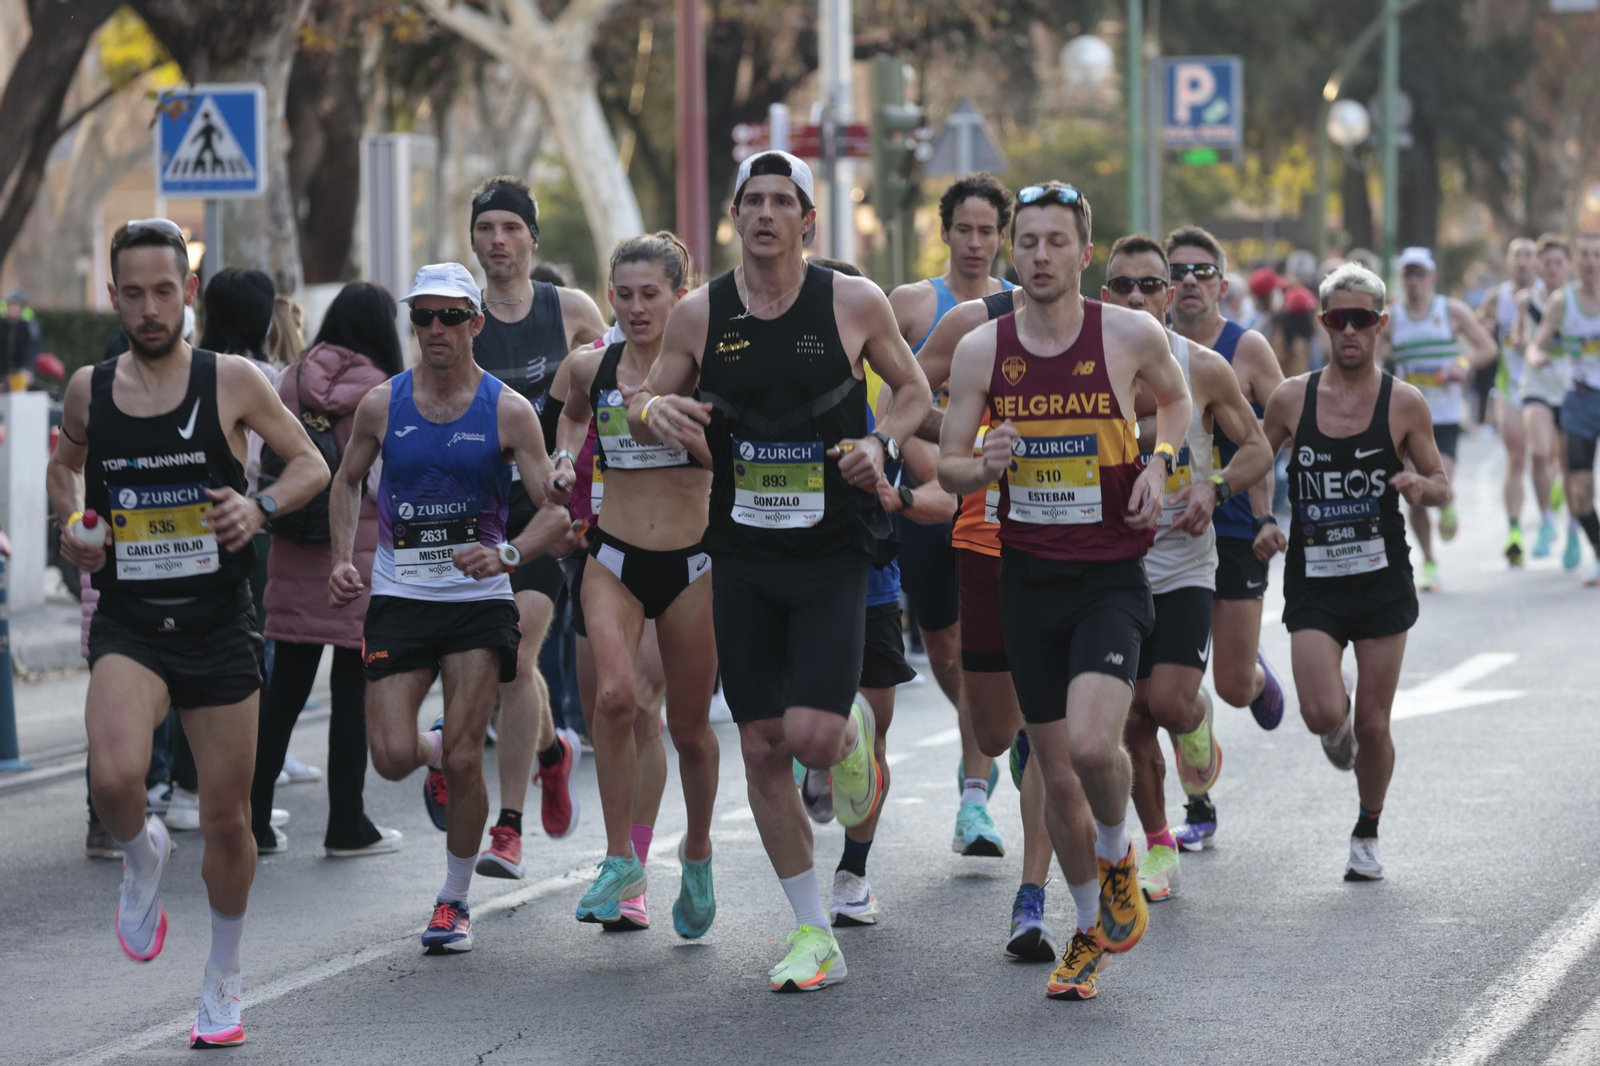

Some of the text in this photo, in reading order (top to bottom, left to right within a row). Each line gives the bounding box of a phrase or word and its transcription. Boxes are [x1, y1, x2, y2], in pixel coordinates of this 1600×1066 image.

[1176, 64, 1216, 122] P
[1072, 360, 1096, 376] NB
[994, 392, 1111, 417] BELGRAVE
[758, 448, 811, 460] ZURICH
[1029, 440, 1085, 455] ZURICH
[102, 451, 206, 472] TOP4RUNNING
[1317, 453, 1332, 462] NN
[762, 475, 787, 488] 893
[1036, 469, 1061, 483] 510
[1298, 469, 1387, 500] INEOS
[140, 488, 199, 505] ZURICH
[754, 495, 800, 507] GONZALO
[1028, 491, 1075, 502] ESTEBAN
[417, 502, 467, 516] ZURICH
[1323, 503, 1370, 518] ZURICH
[149, 520, 175, 534] 535
[1326, 527, 1356, 542] 2548
[420, 528, 448, 543] 2631
[127, 540, 203, 557] CARLOS ROJO
[1326, 544, 1363, 558] FLORIPA
[1104, 650, 1124, 666] NB
